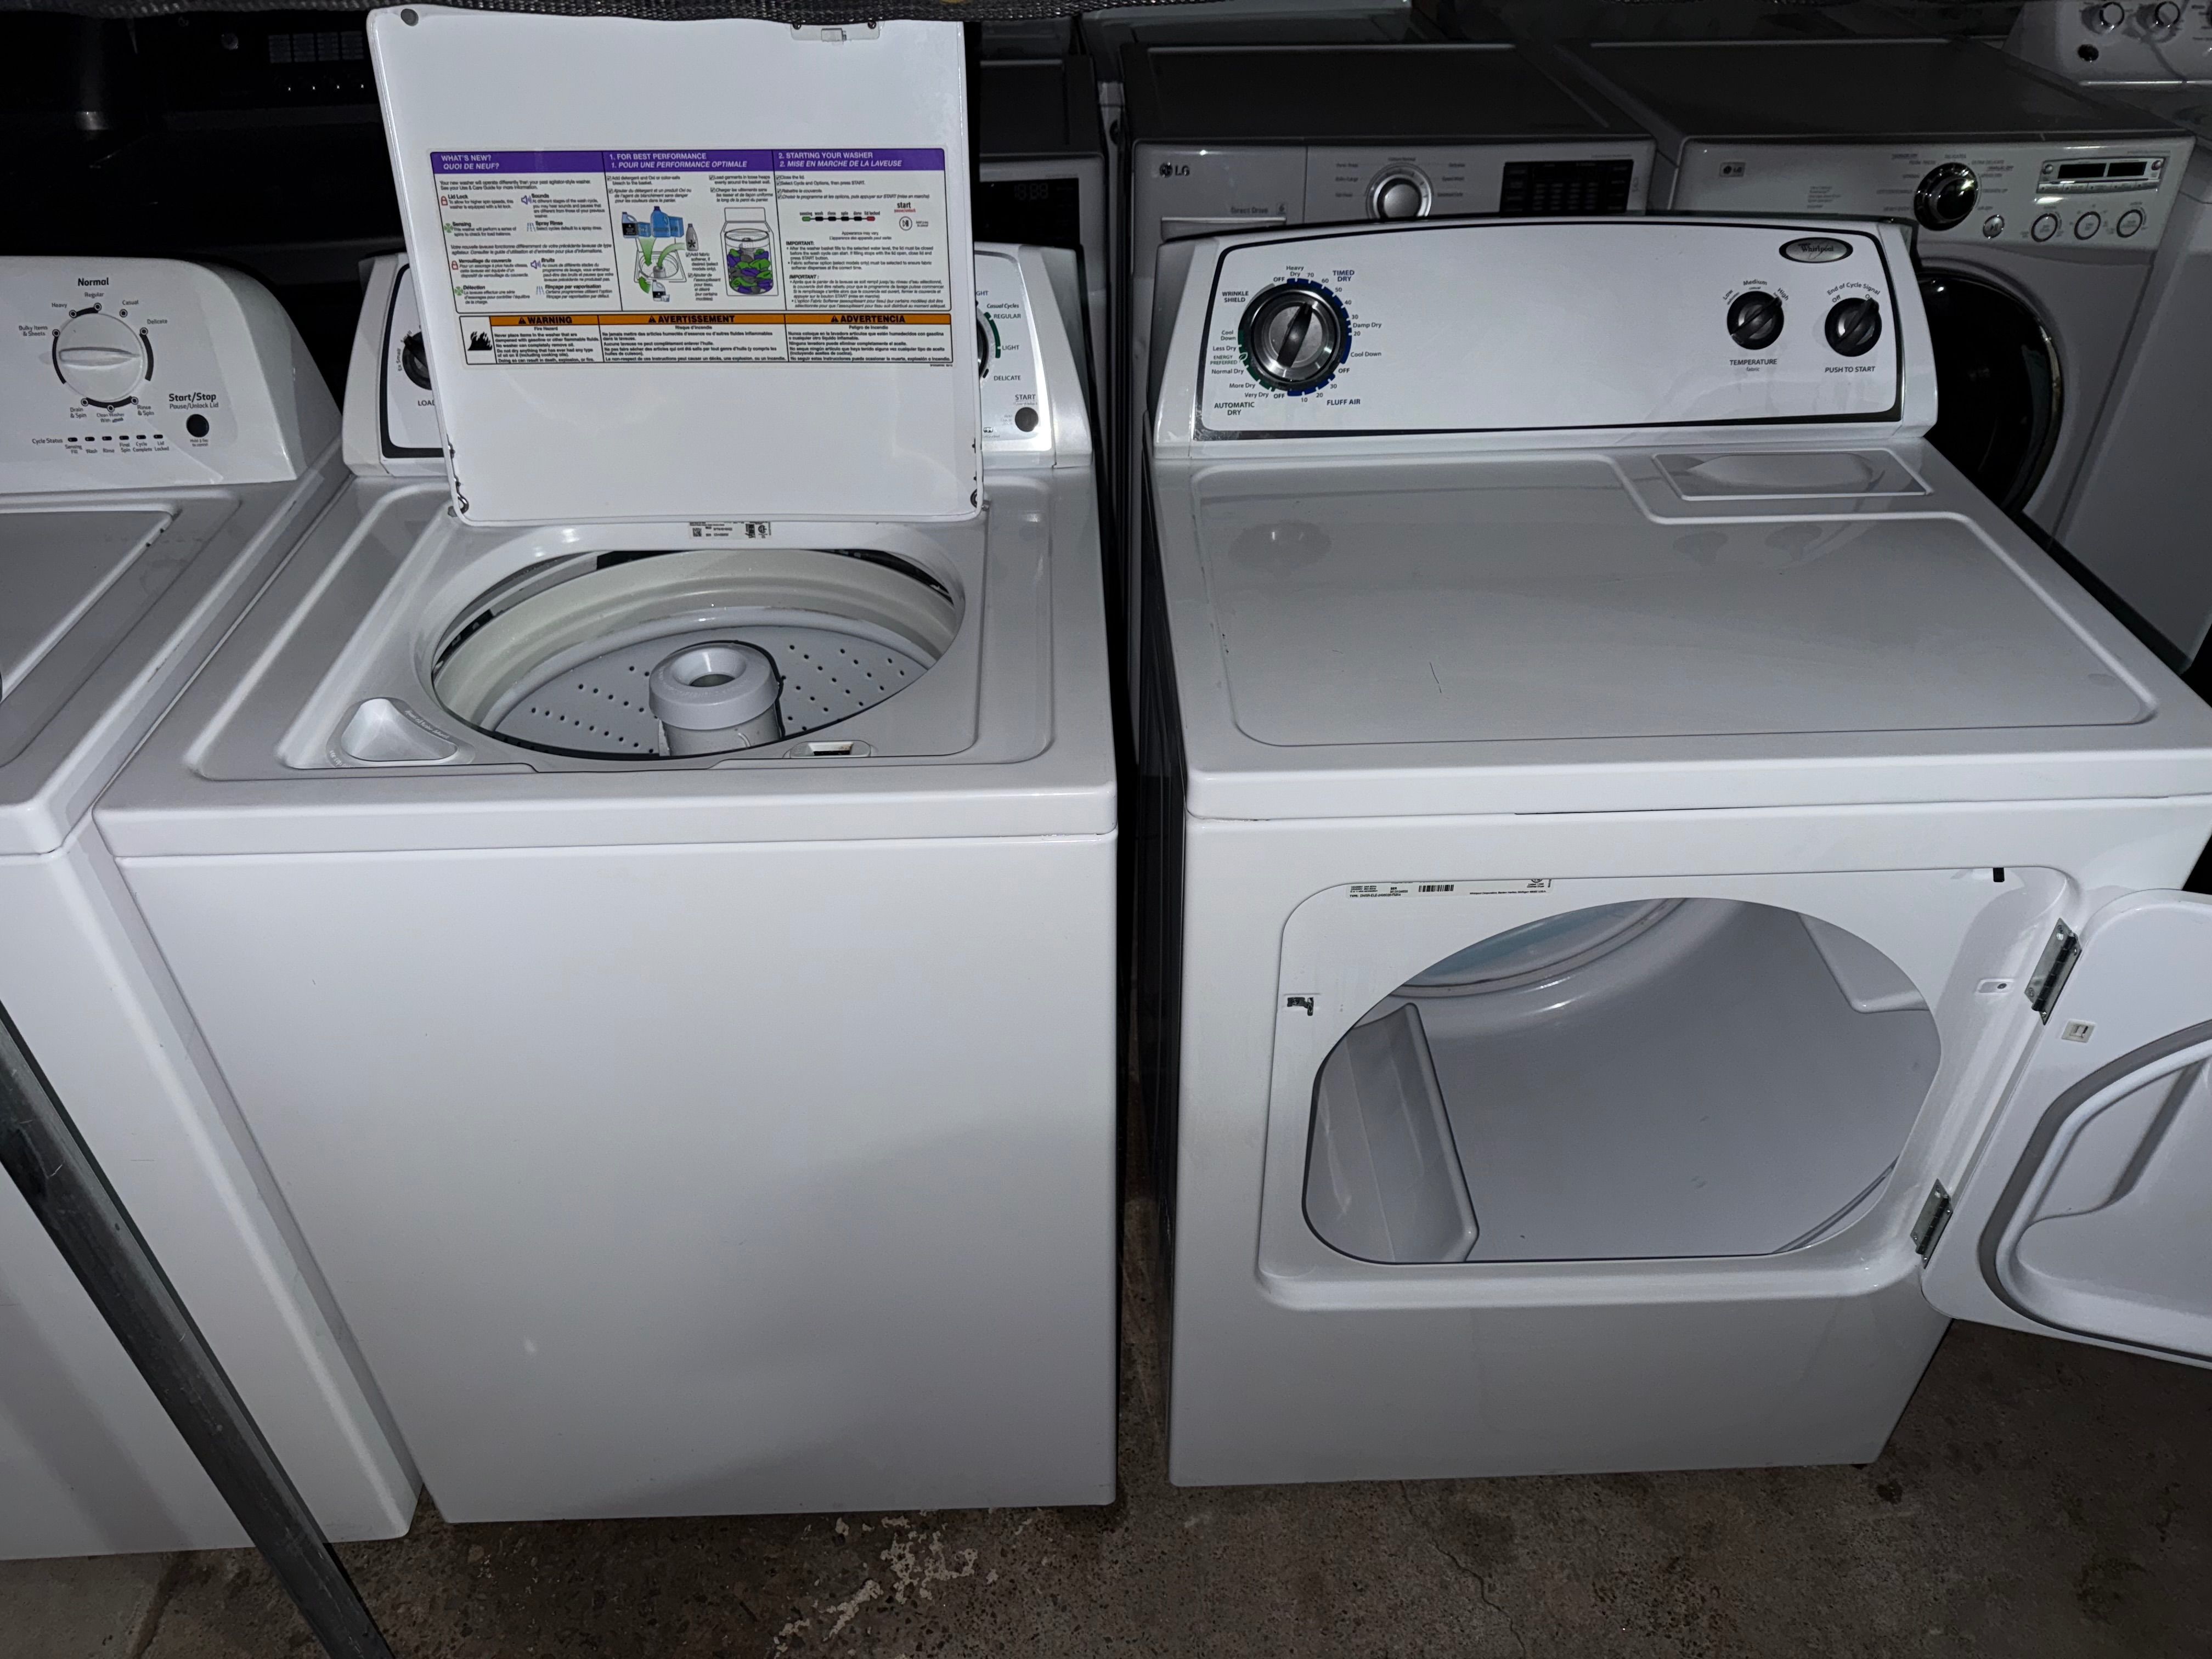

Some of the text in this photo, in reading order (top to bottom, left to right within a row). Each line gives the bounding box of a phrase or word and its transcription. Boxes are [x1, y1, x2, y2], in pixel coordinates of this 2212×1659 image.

[1175, 165, 1190, 176] LG
[1800, 245, 1833, 253] Whirlpool
[78, 278, 109, 286] Normal
[1723, 290, 1733, 300] Low
[1778, 287, 1789, 301] High
[1827, 286, 1838, 296] End
[1863, 284, 1880, 295] Signal
[1832, 295, 1841, 303] Off
[169, 392, 216, 402] Start/Stop
